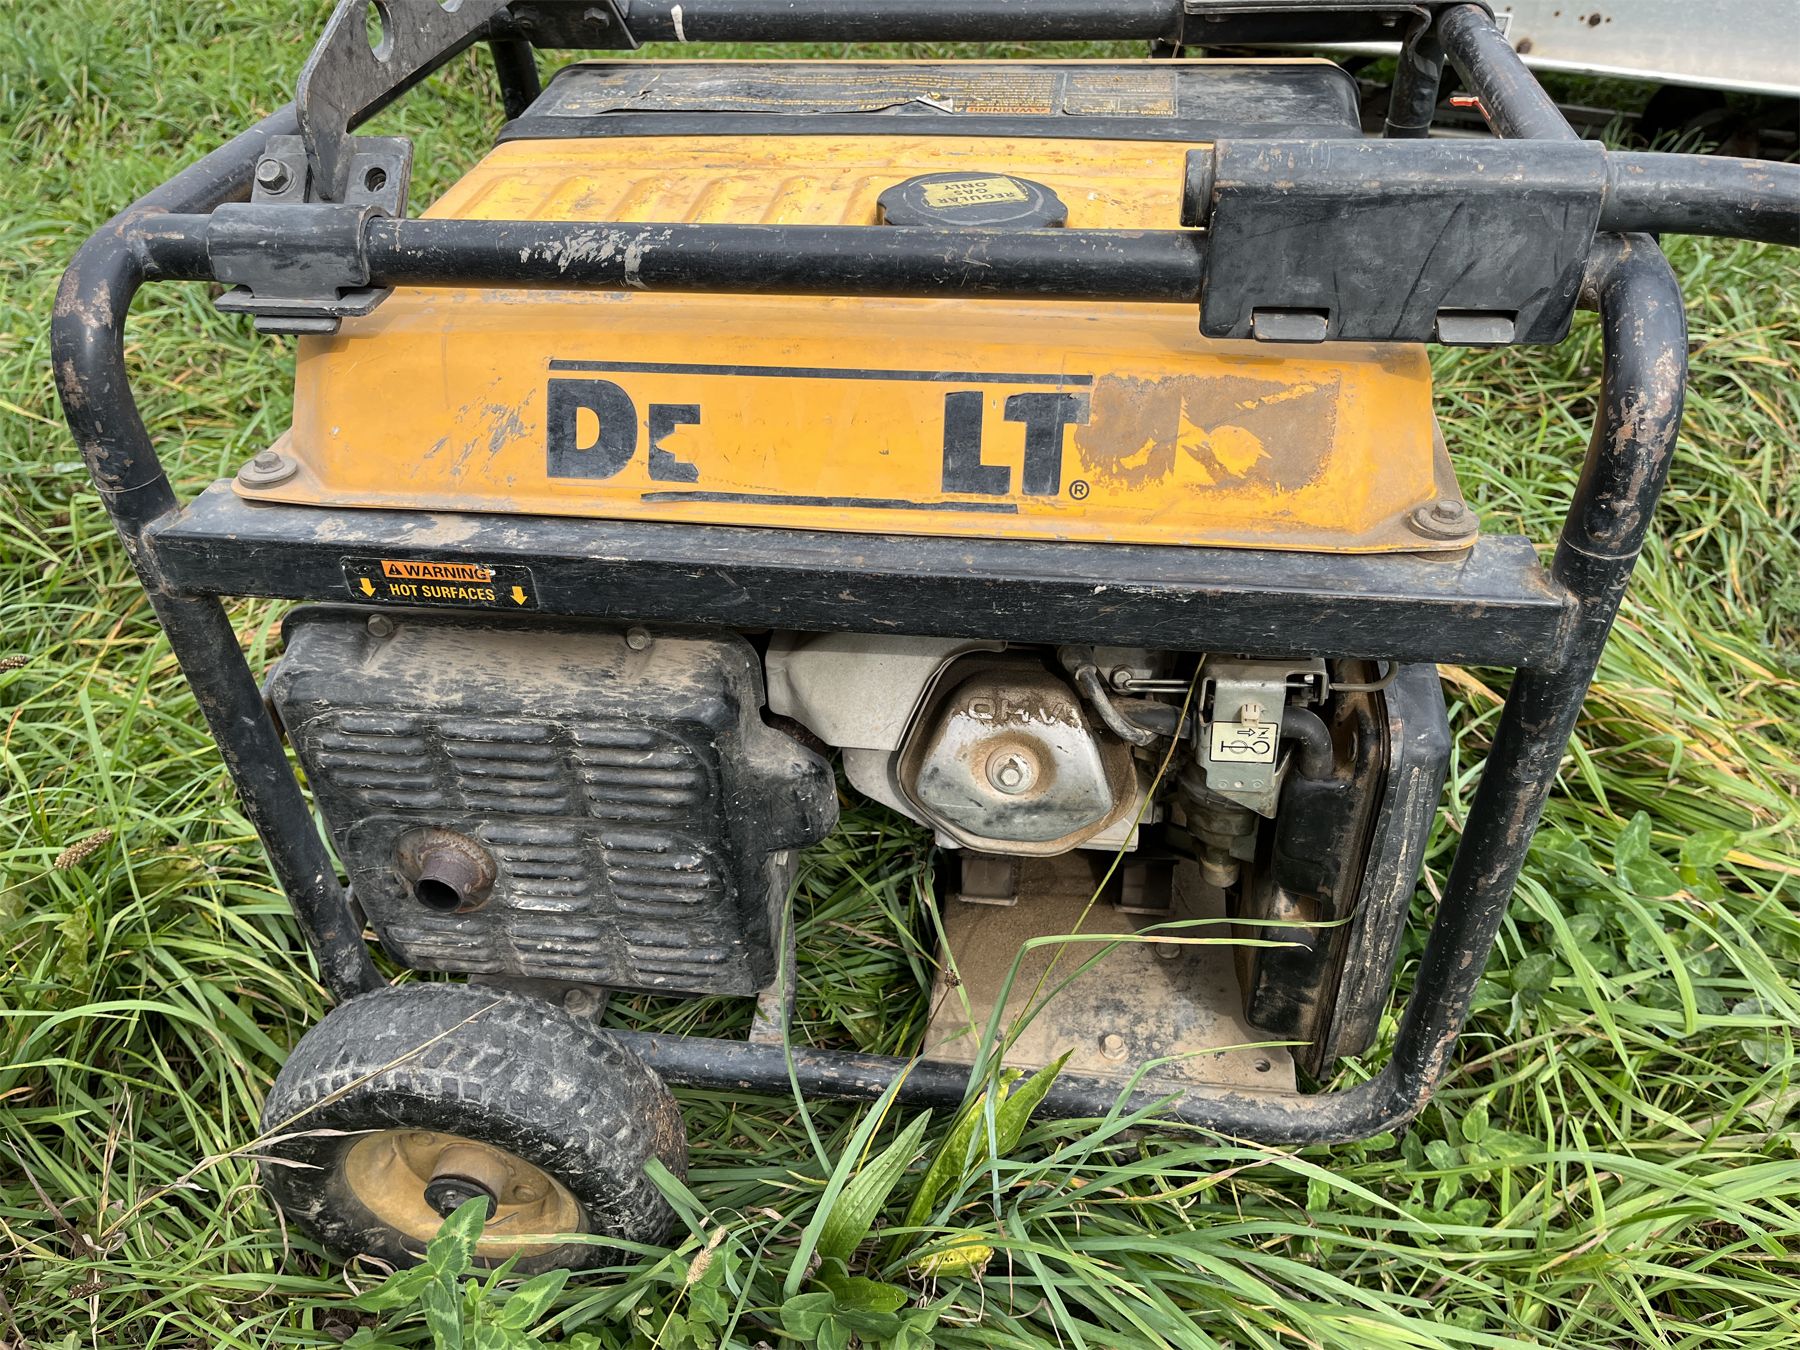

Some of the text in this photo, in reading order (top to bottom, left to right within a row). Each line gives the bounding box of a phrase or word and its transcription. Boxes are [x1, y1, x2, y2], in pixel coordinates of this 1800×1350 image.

[944, 182, 987, 190] ONLY
[954, 188, 988, 196] GAS
[937, 192, 1015, 204] REGULAR
[403, 564, 488, 580] WARNING
[389, 583, 496, 601] HOT SURFACES
